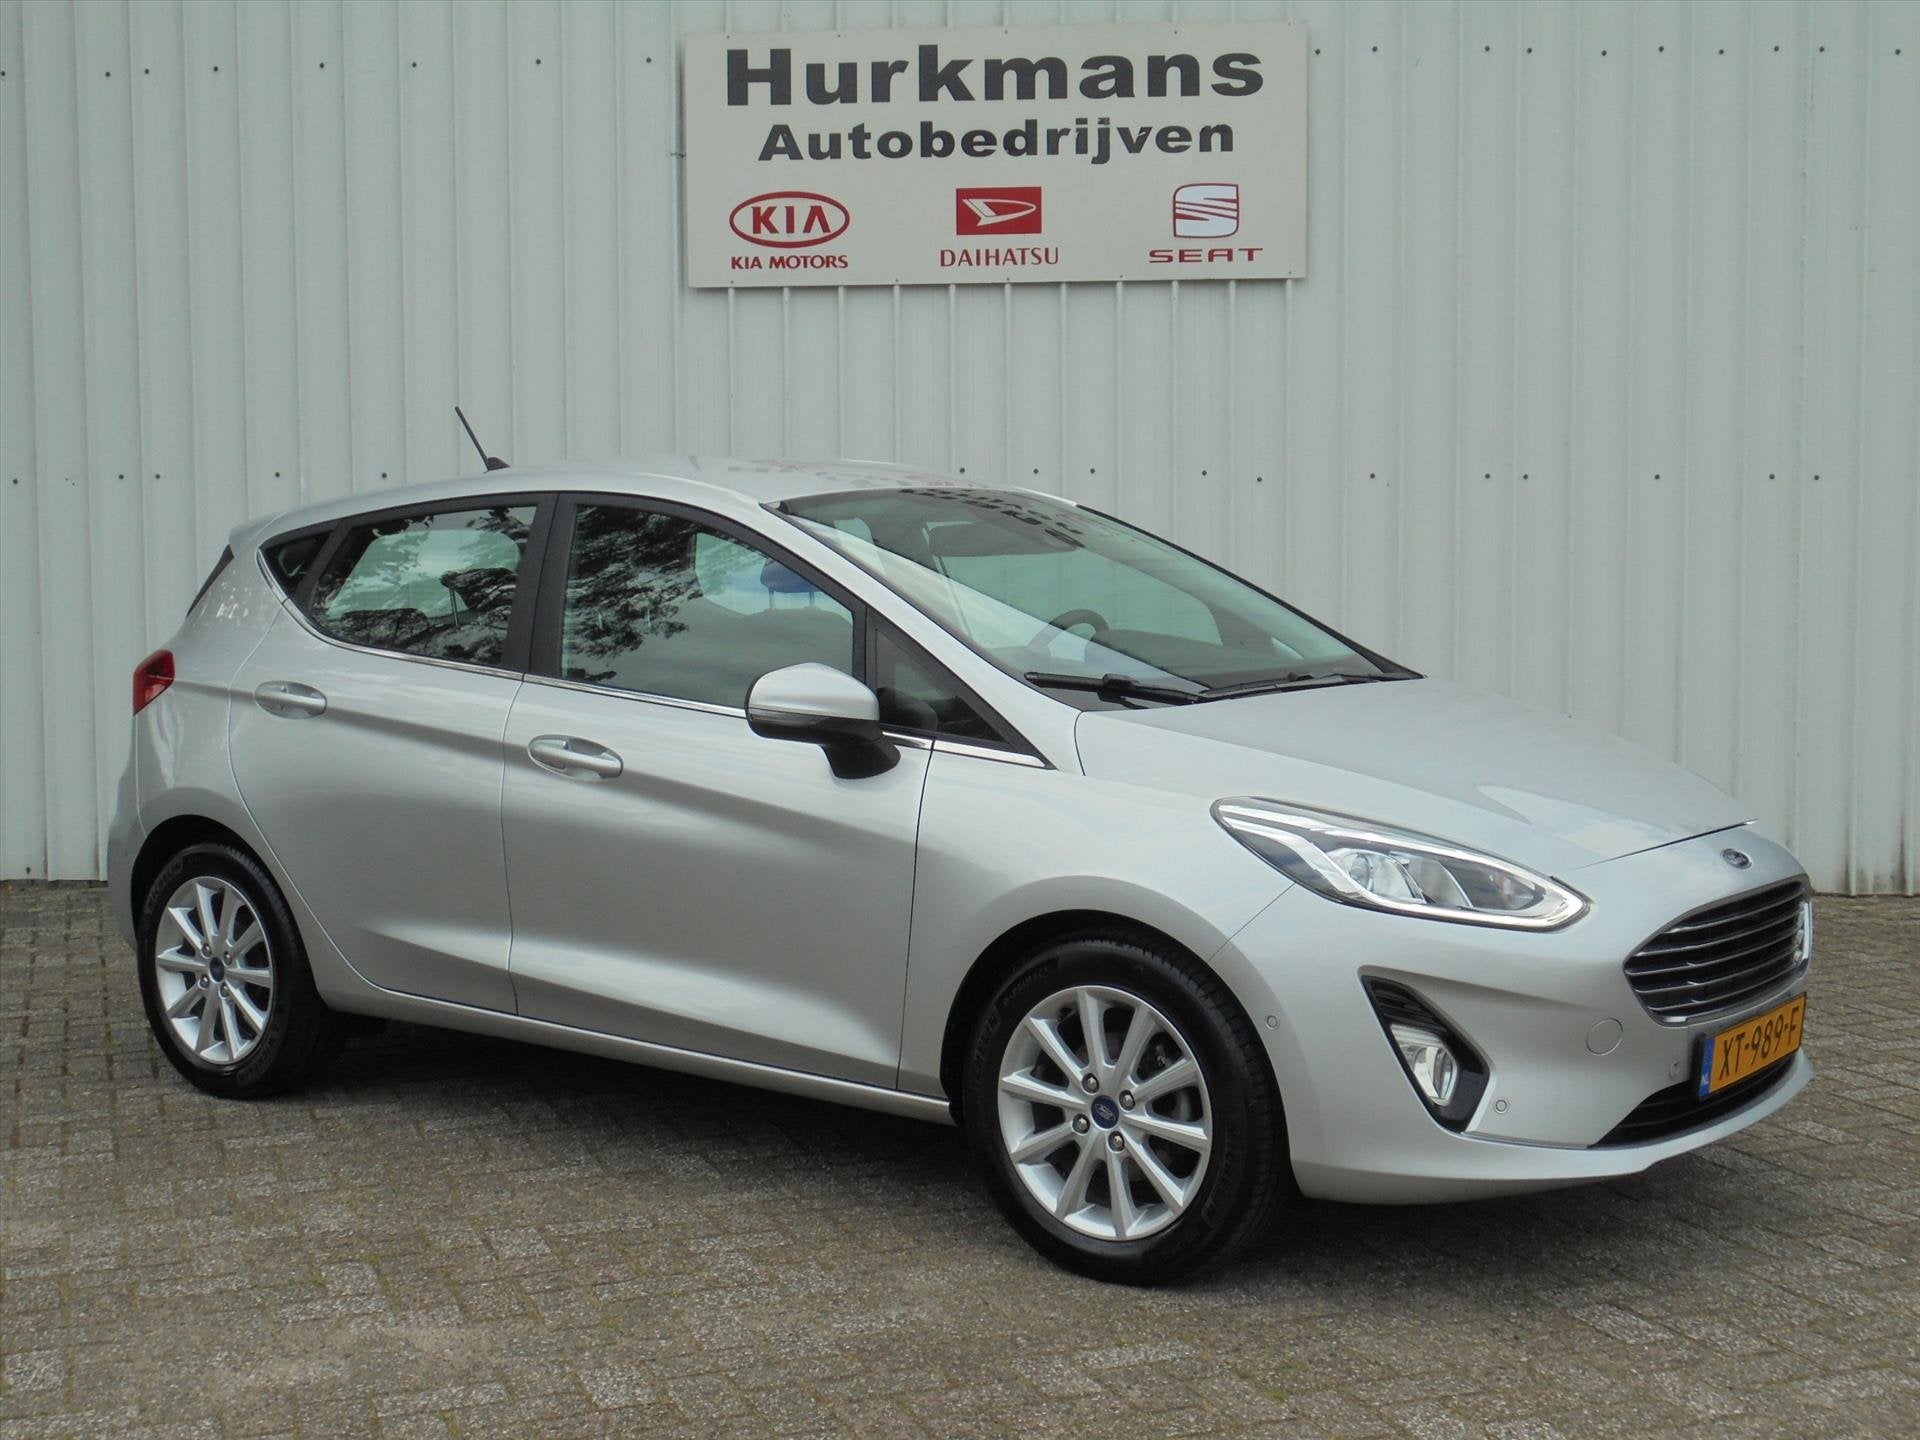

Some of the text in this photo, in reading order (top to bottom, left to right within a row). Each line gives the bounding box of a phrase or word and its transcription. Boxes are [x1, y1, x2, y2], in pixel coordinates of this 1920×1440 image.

[727, 44, 1264, 106] Hurkmans
[758, 117, 1234, 165] Autobedrijven
[751, 204, 832, 235] KIA
[731, 255, 849, 269] KIA MOTORS
[940, 247, 1060, 267] DAIHATSU
[1149, 247, 1264, 263] SEAT
[1718, 1005, 1800, 1081] XT-989-F
